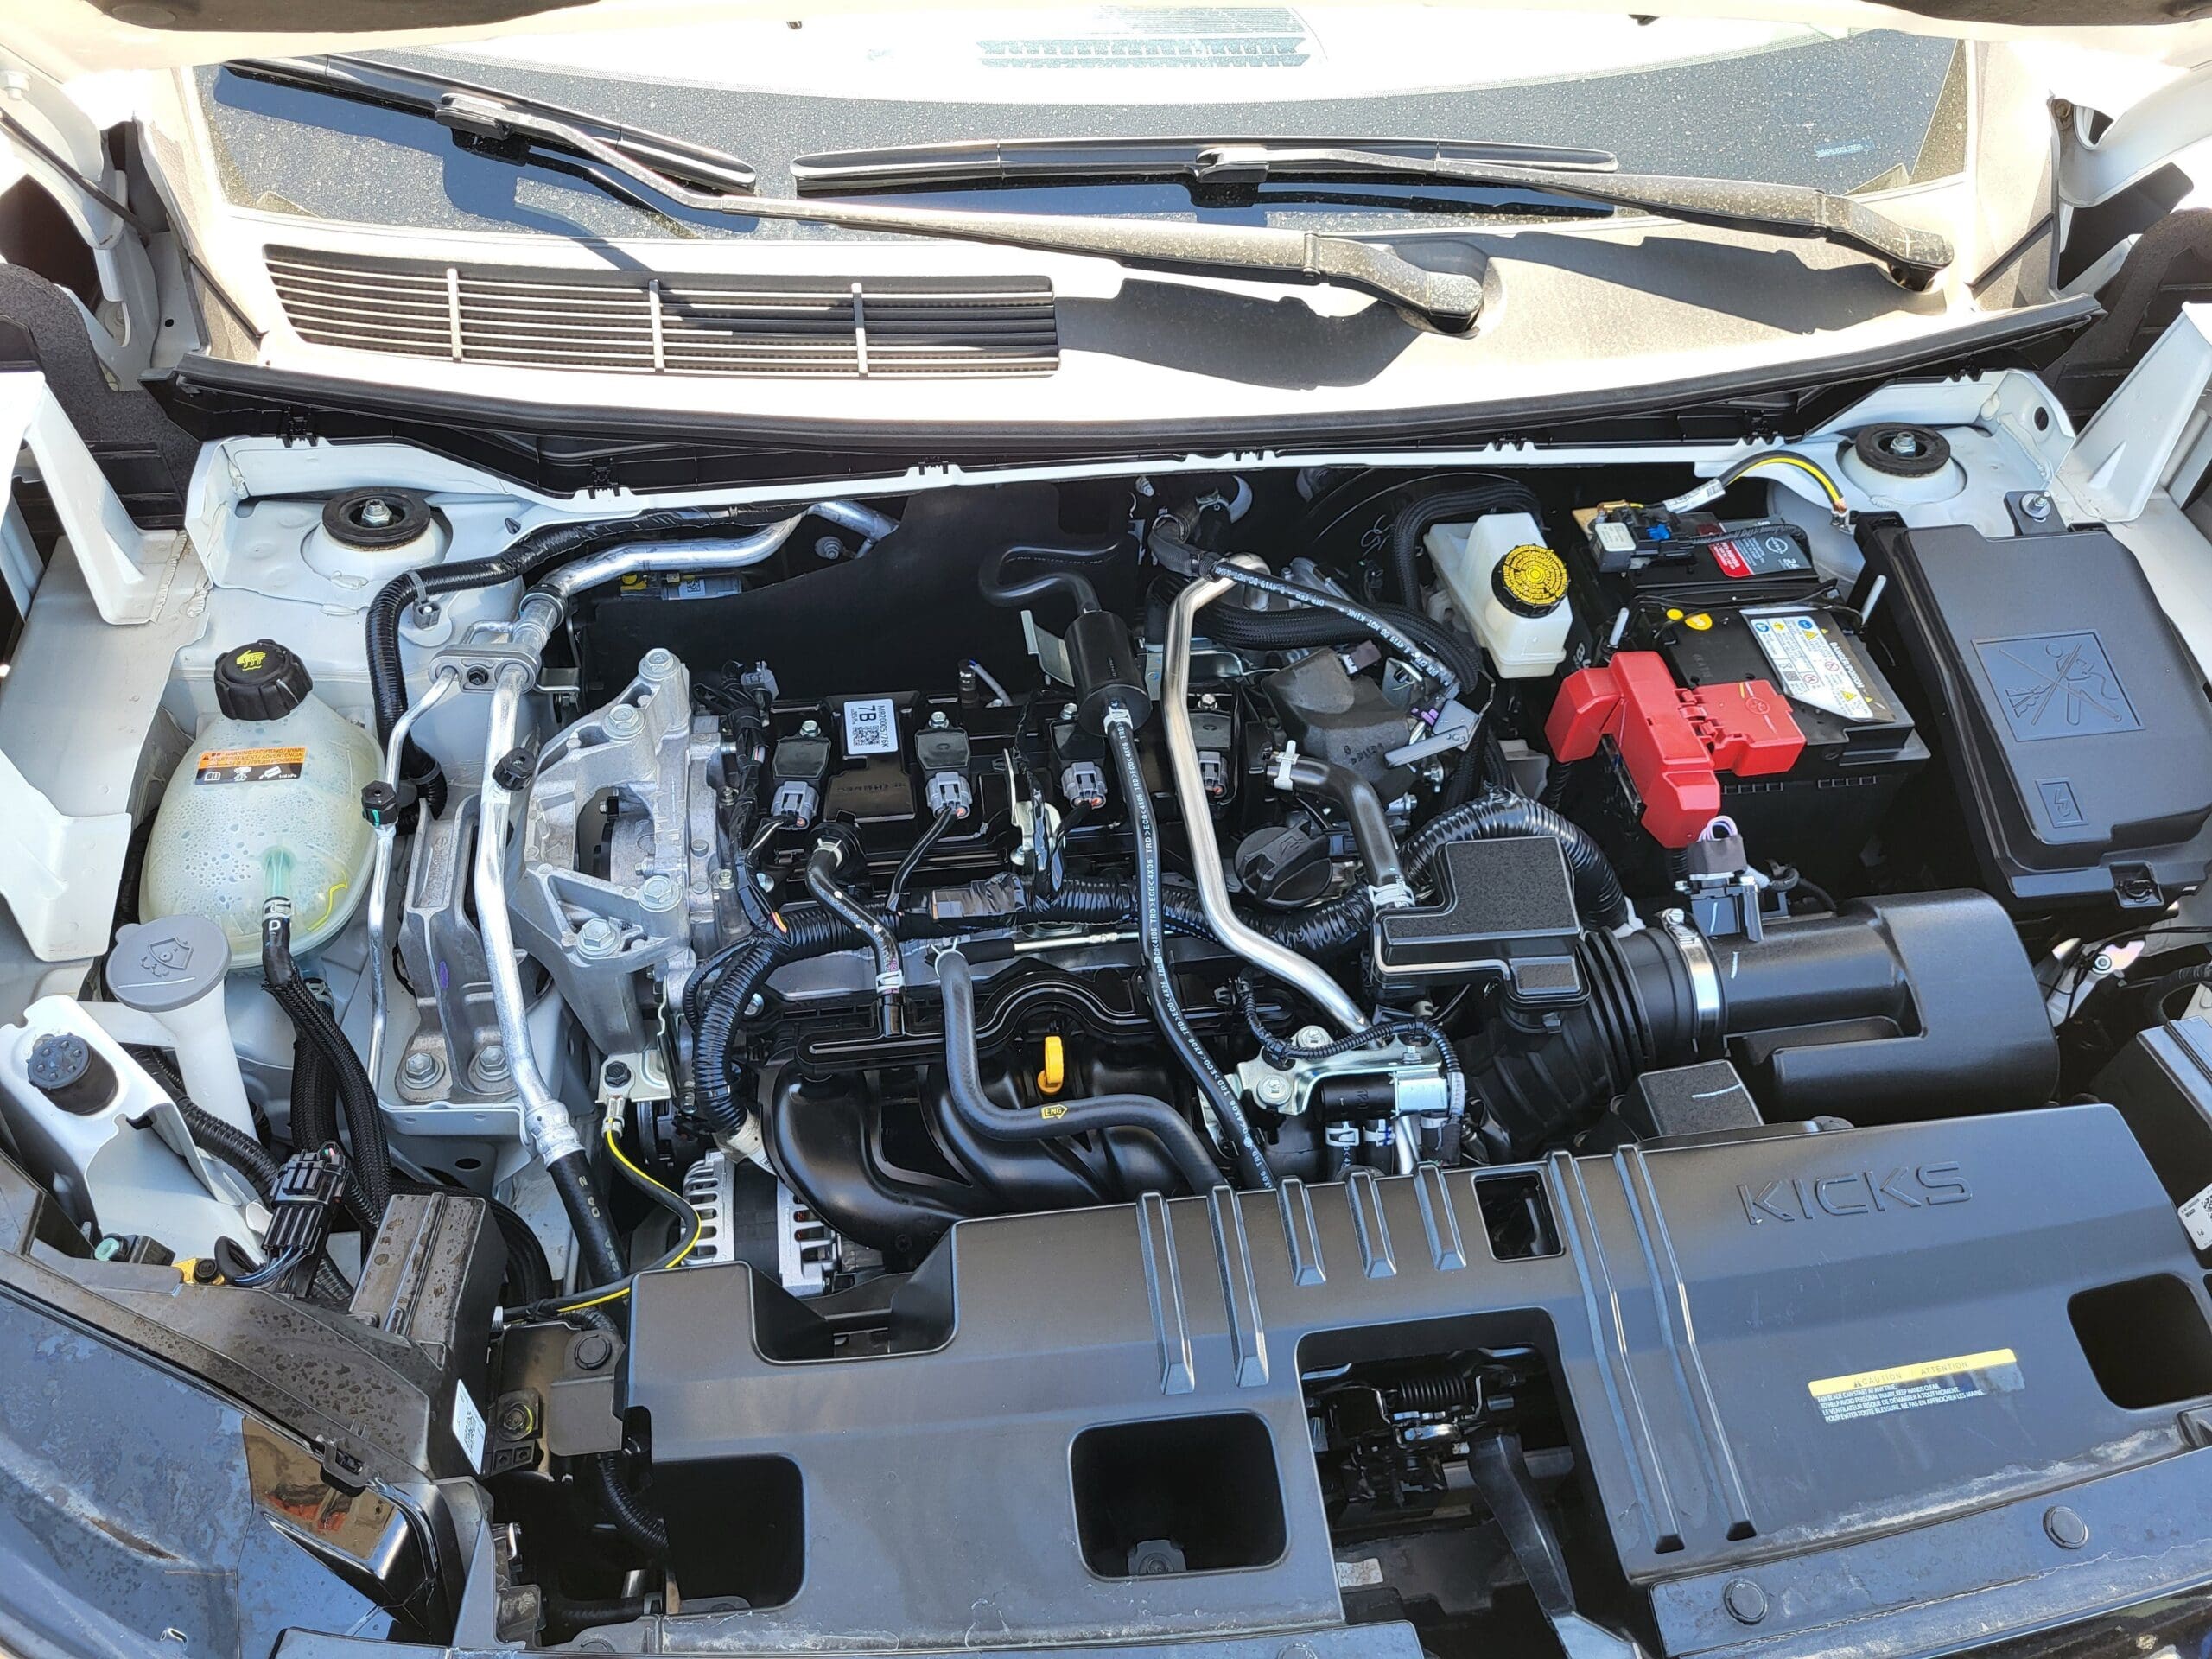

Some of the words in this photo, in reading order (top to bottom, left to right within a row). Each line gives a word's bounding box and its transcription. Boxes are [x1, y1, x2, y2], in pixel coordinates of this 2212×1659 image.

[1347, 609, 1365, 621] KINK
[858, 705, 876, 721] 7B
[1046, 1107, 1063, 1116] ENG
[1736, 1160, 1974, 1226] KICKS
[604, 1236, 620, 1273] 25A
[1862, 1371, 1902, 1385] CAUTION
[1921, 1361, 1968, 1376] ATTENTION
